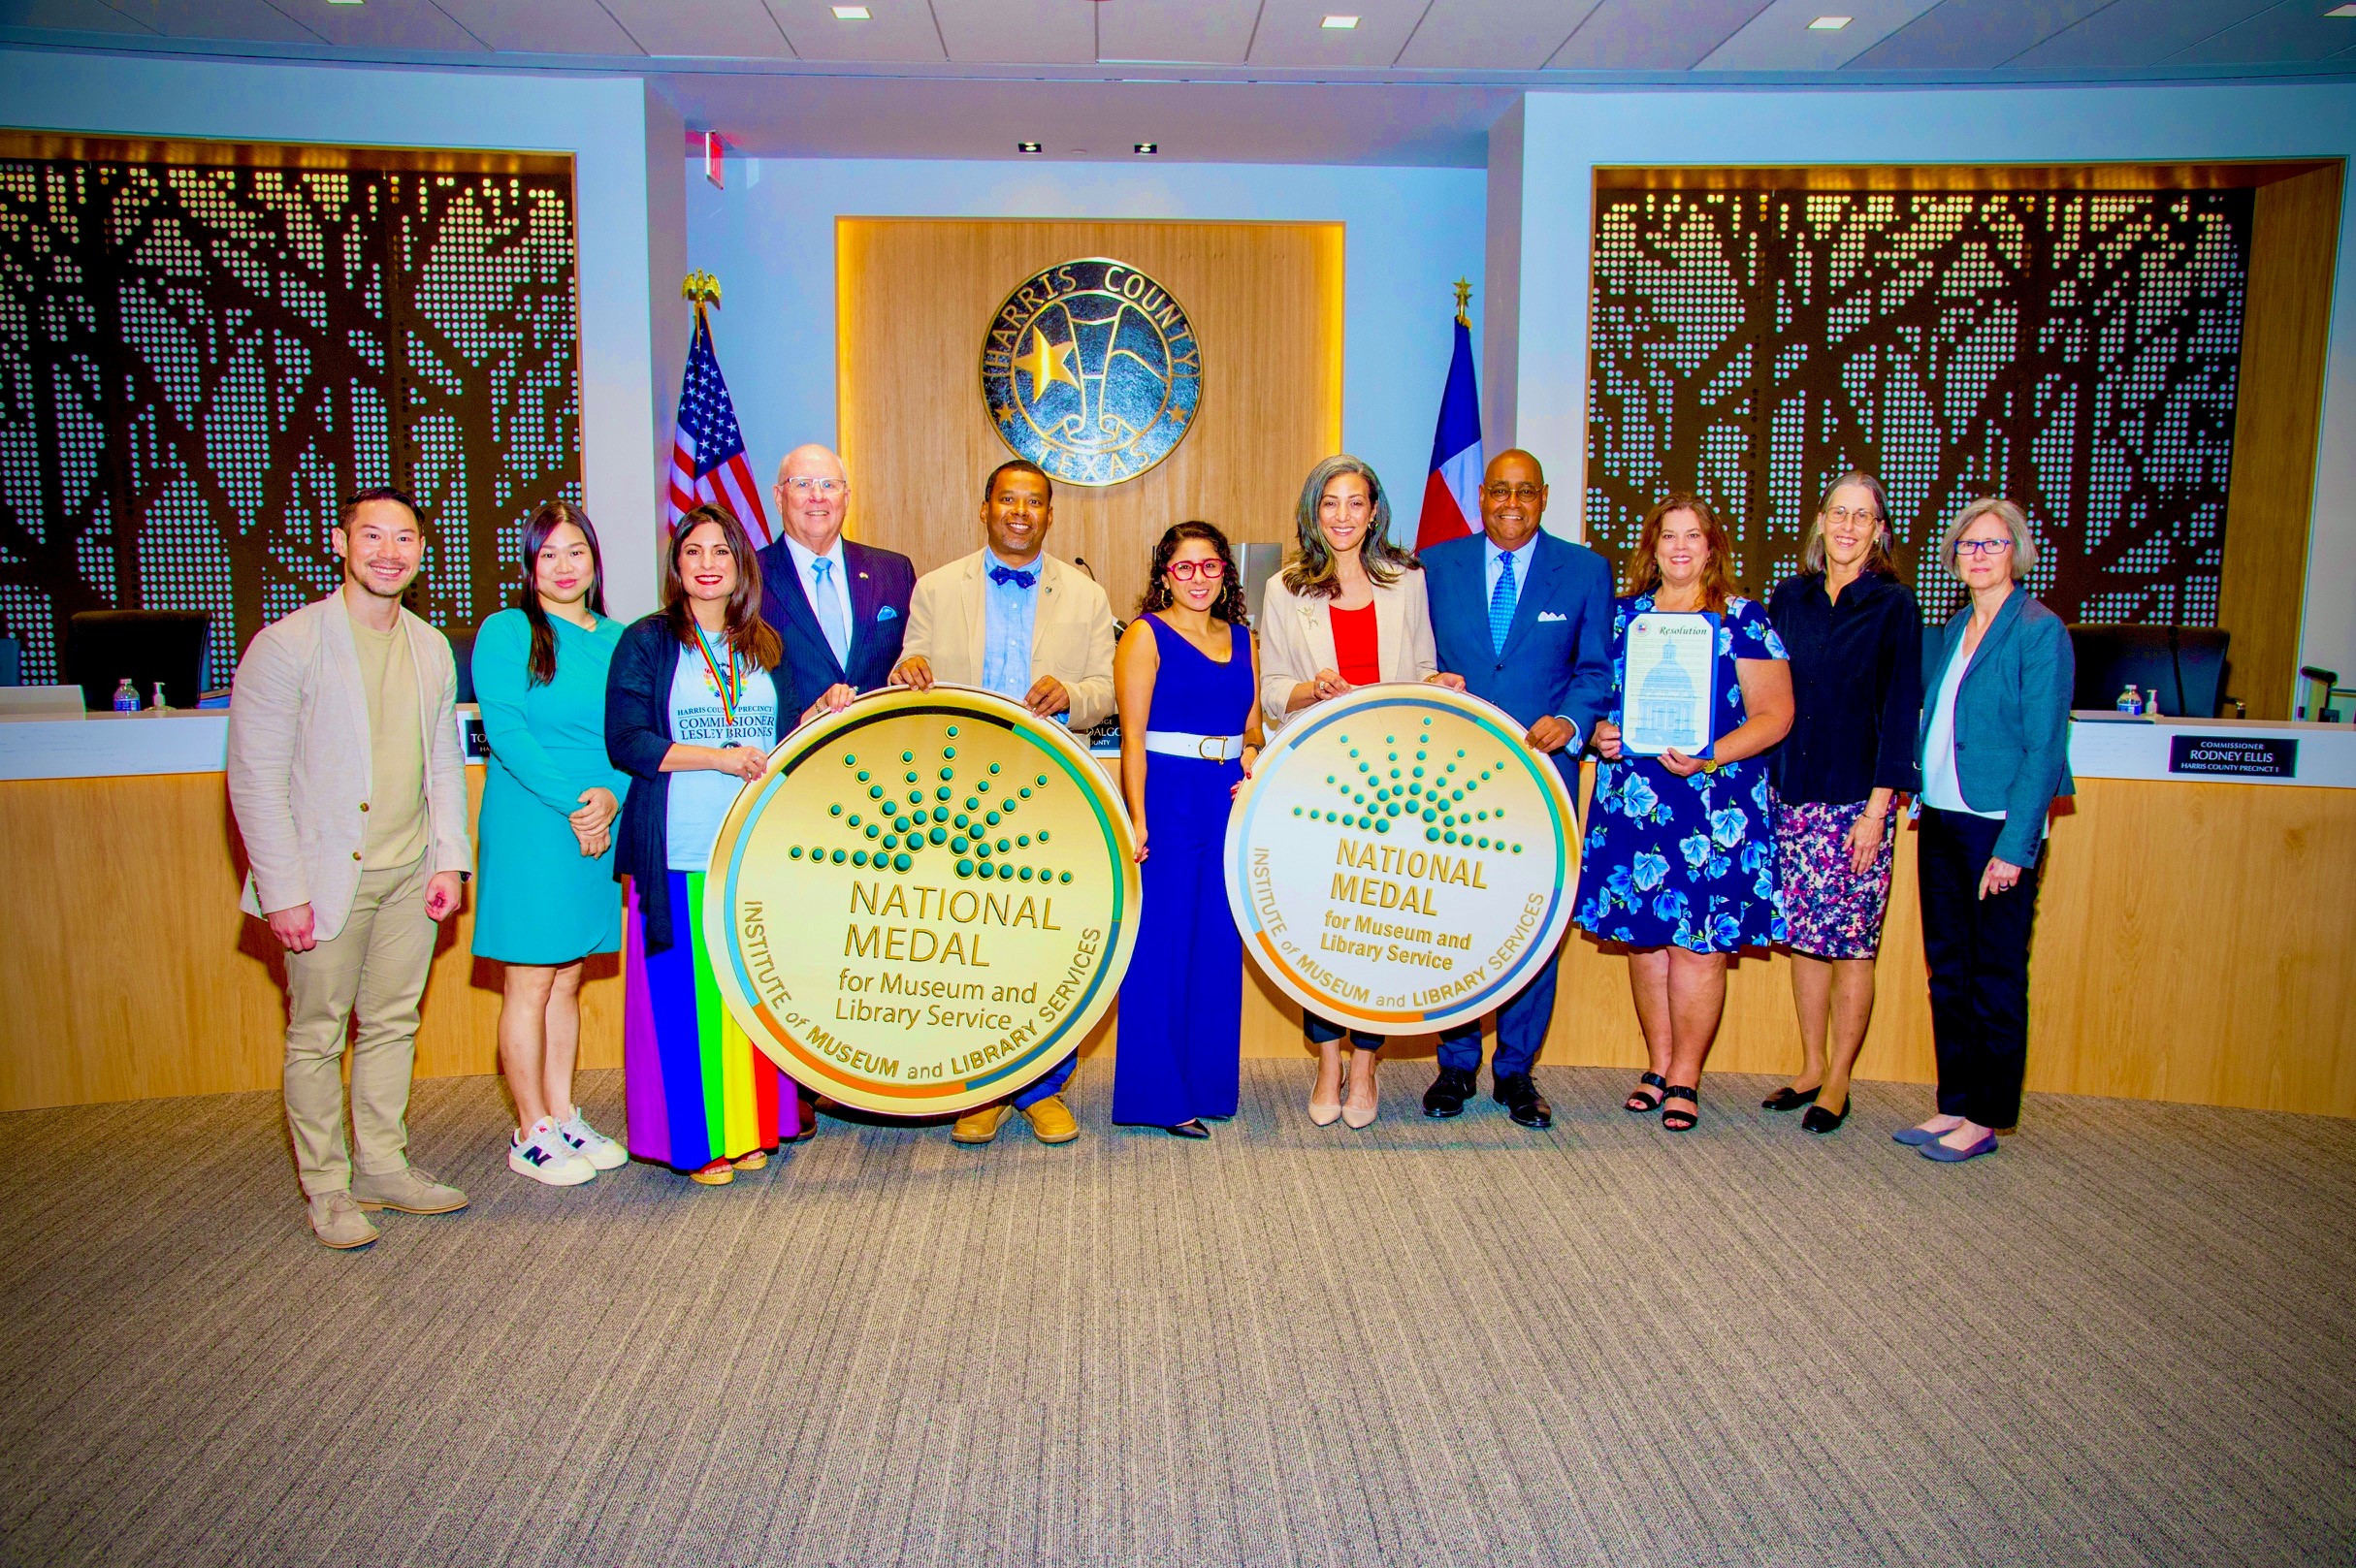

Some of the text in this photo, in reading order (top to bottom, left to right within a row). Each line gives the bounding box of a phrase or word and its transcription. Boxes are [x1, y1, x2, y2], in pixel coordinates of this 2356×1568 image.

[984, 266, 1200, 368] HARRIS COUNTY
[1037, 439, 1150, 481] TEXAS
[1659, 624, 1707, 635] Resolution
[677, 706, 706, 716] HARRIS
[469, 733, 487, 743] TO
[681, 727, 773, 740] LESLEY BRIONES
[1085, 727, 1122, 737] DALGO
[2200, 741, 2264, 751] COMMISSIONER
[2190, 750, 2274, 763] RODNEY ELLIS
[2239, 764, 2274, 773] PRECINCT
[1337, 838, 1488, 890] NATIONAL
[851, 880, 1061, 931] NATIONAL
[1331, 872, 1438, 916] MEDAL
[844, 923, 990, 968] MEDAL
[1254, 848, 1544, 1008] INSTITUTE of MUSEUM and LIBRARY SERVICES
[1324, 910, 1472, 950] for Museum and
[1320, 932, 1454, 971] Library Service
[744, 901, 1101, 1079] INSTITUTE of MUSEUM and LIBRARY SERVICES
[839, 968, 1038, 1004] for Museum and
[835, 998, 1012, 1030] Library Service
